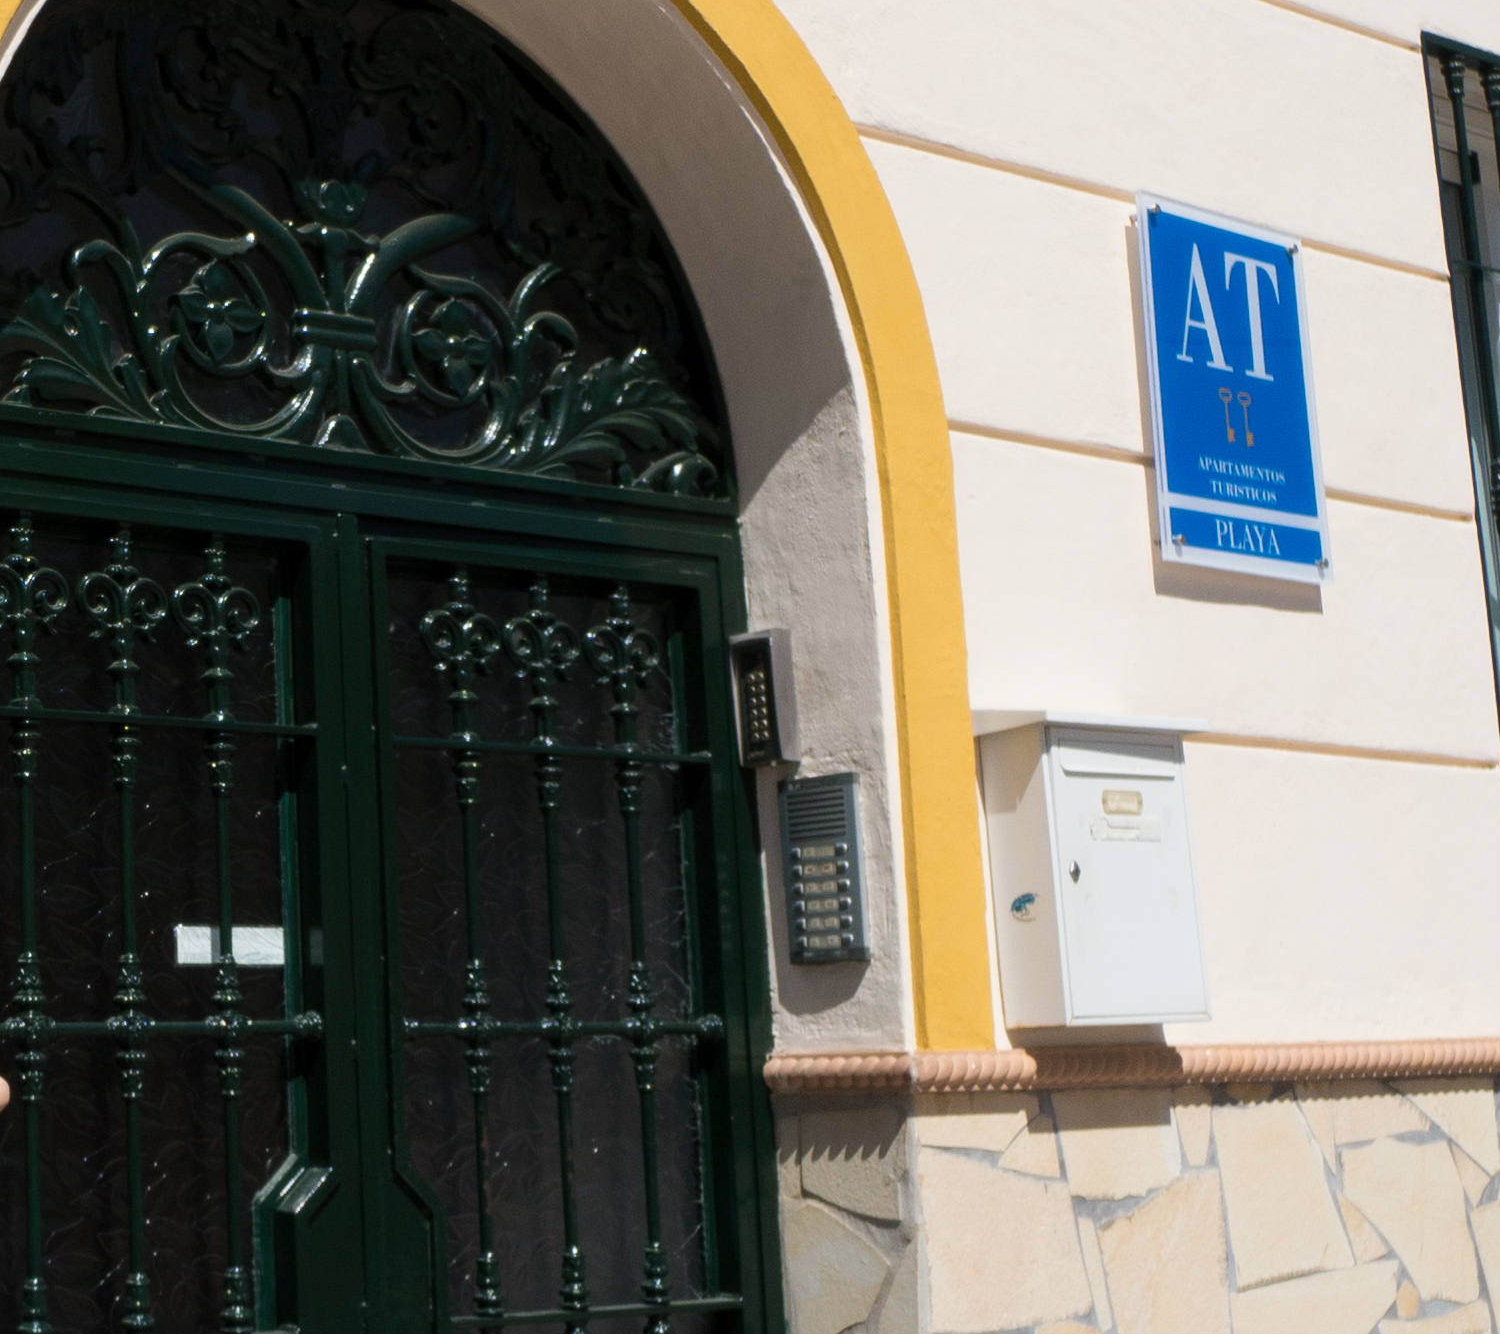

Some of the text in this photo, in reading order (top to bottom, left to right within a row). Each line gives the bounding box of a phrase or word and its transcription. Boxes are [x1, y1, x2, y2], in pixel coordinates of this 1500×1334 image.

[1176, 242, 1281, 382] AT
[1198, 455, 1286, 485] APARTAMENTOS
[1216, 519, 1281, 556] PLAYA
